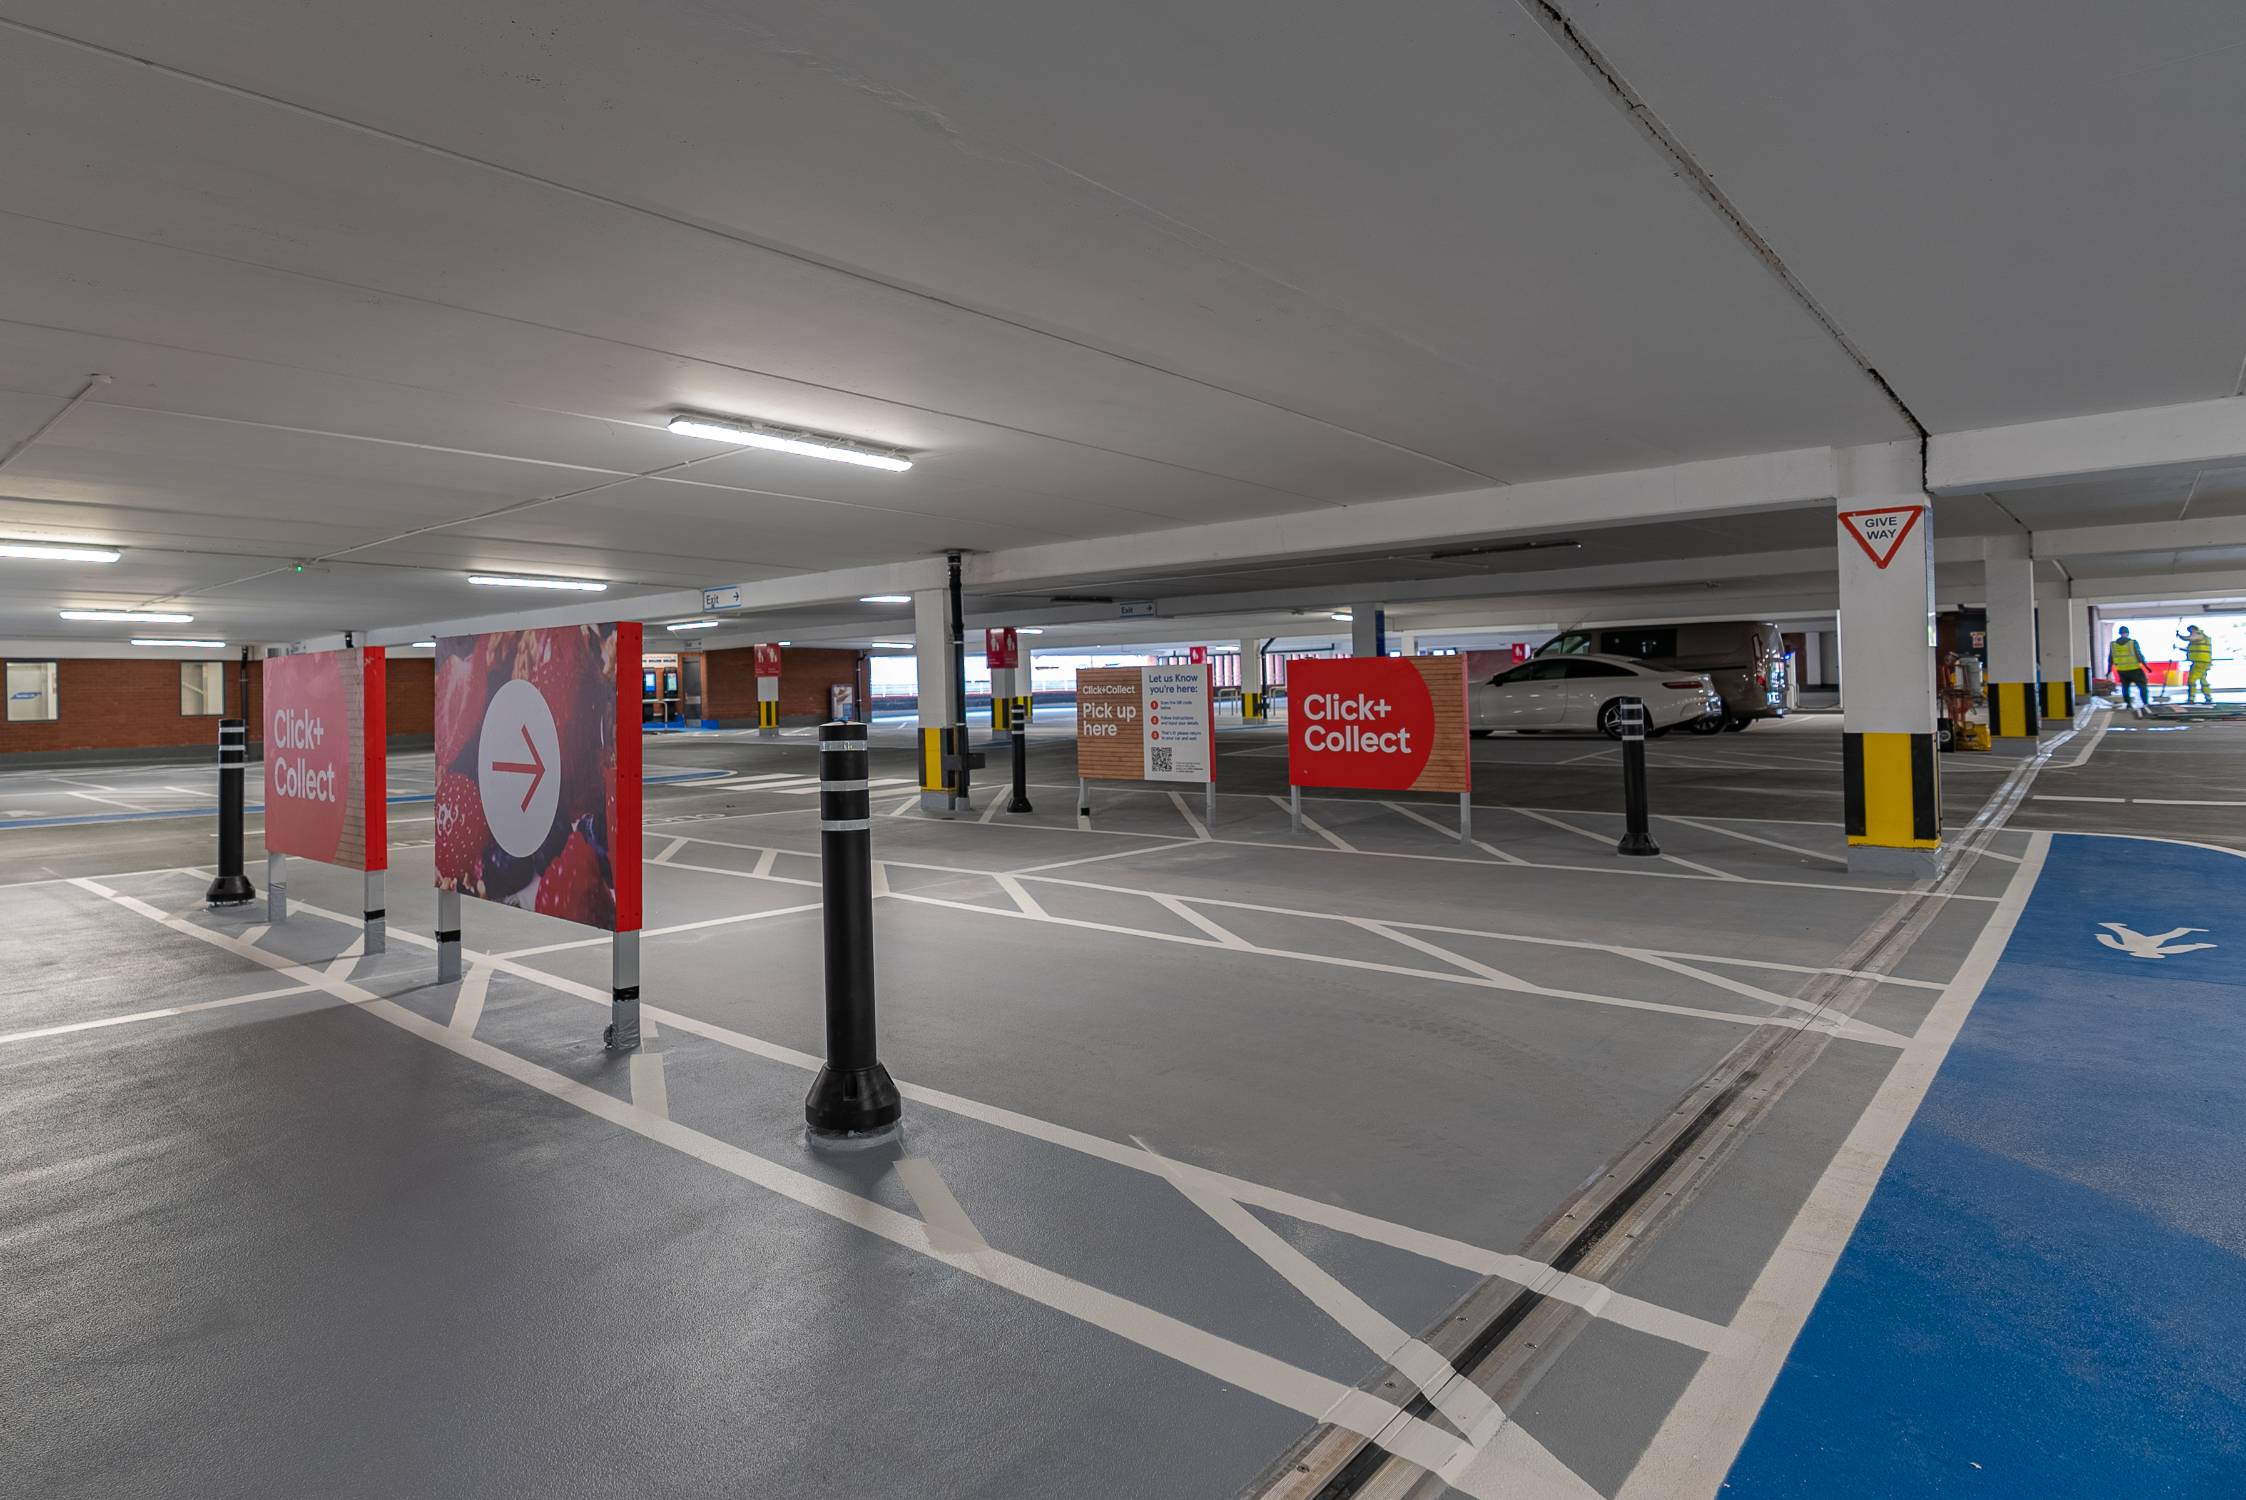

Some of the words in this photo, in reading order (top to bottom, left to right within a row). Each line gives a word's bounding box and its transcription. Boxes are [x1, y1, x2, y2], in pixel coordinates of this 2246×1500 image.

[1865, 516, 1897, 528] GIVE
[1866, 529, 1897, 540] WAY
[706, 594, 719, 607] Exit
[1149, 674, 1162, 683] Let
[1164, 675, 1174, 683] us
[1175, 673, 1198, 682] Know
[1082, 685, 1136, 695] Click+Collect
[1150, 685, 1175, 695] you're
[1177, 684, 1198, 693] here:
[1083, 702, 1113, 718] Pick
[1117, 705, 1137, 722] up
[1303, 693, 1392, 720] Click+
[274, 708, 324, 750] Click+
[1083, 720, 1117, 736] here
[1304, 725, 1412, 754] Collect
[274, 756, 336, 803] Collect
